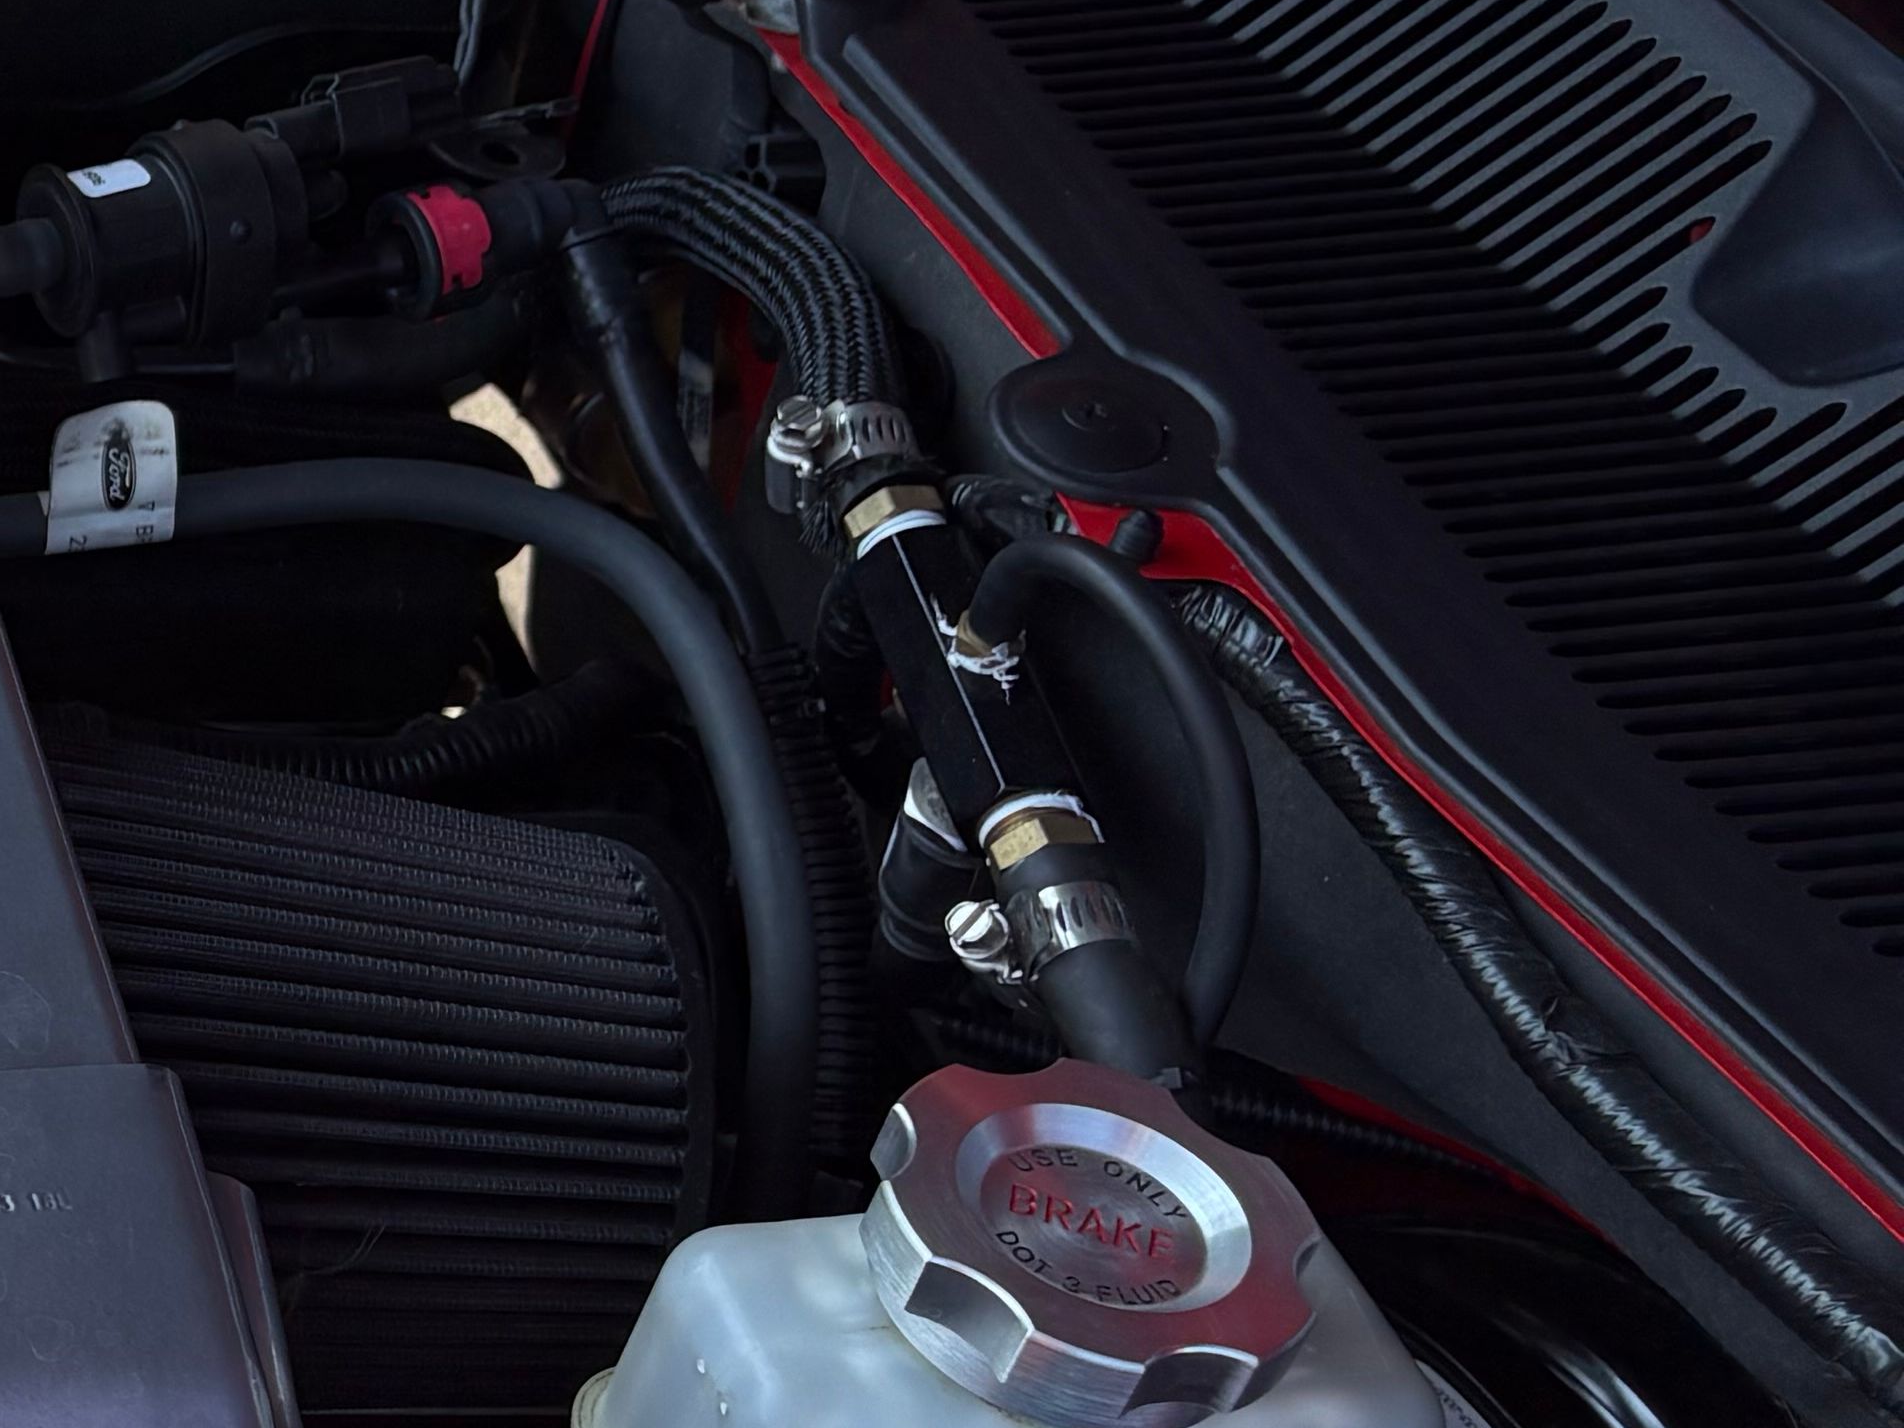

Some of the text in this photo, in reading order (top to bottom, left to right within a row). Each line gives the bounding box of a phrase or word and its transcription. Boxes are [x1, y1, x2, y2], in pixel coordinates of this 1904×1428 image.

[106, 446, 132, 503] Ford
[1008, 1148, 1189, 1219] USE ONLY
[1009, 1183, 1175, 1260] BRAKE
[995, 1230, 1182, 1306] DOT 3 FLUID
